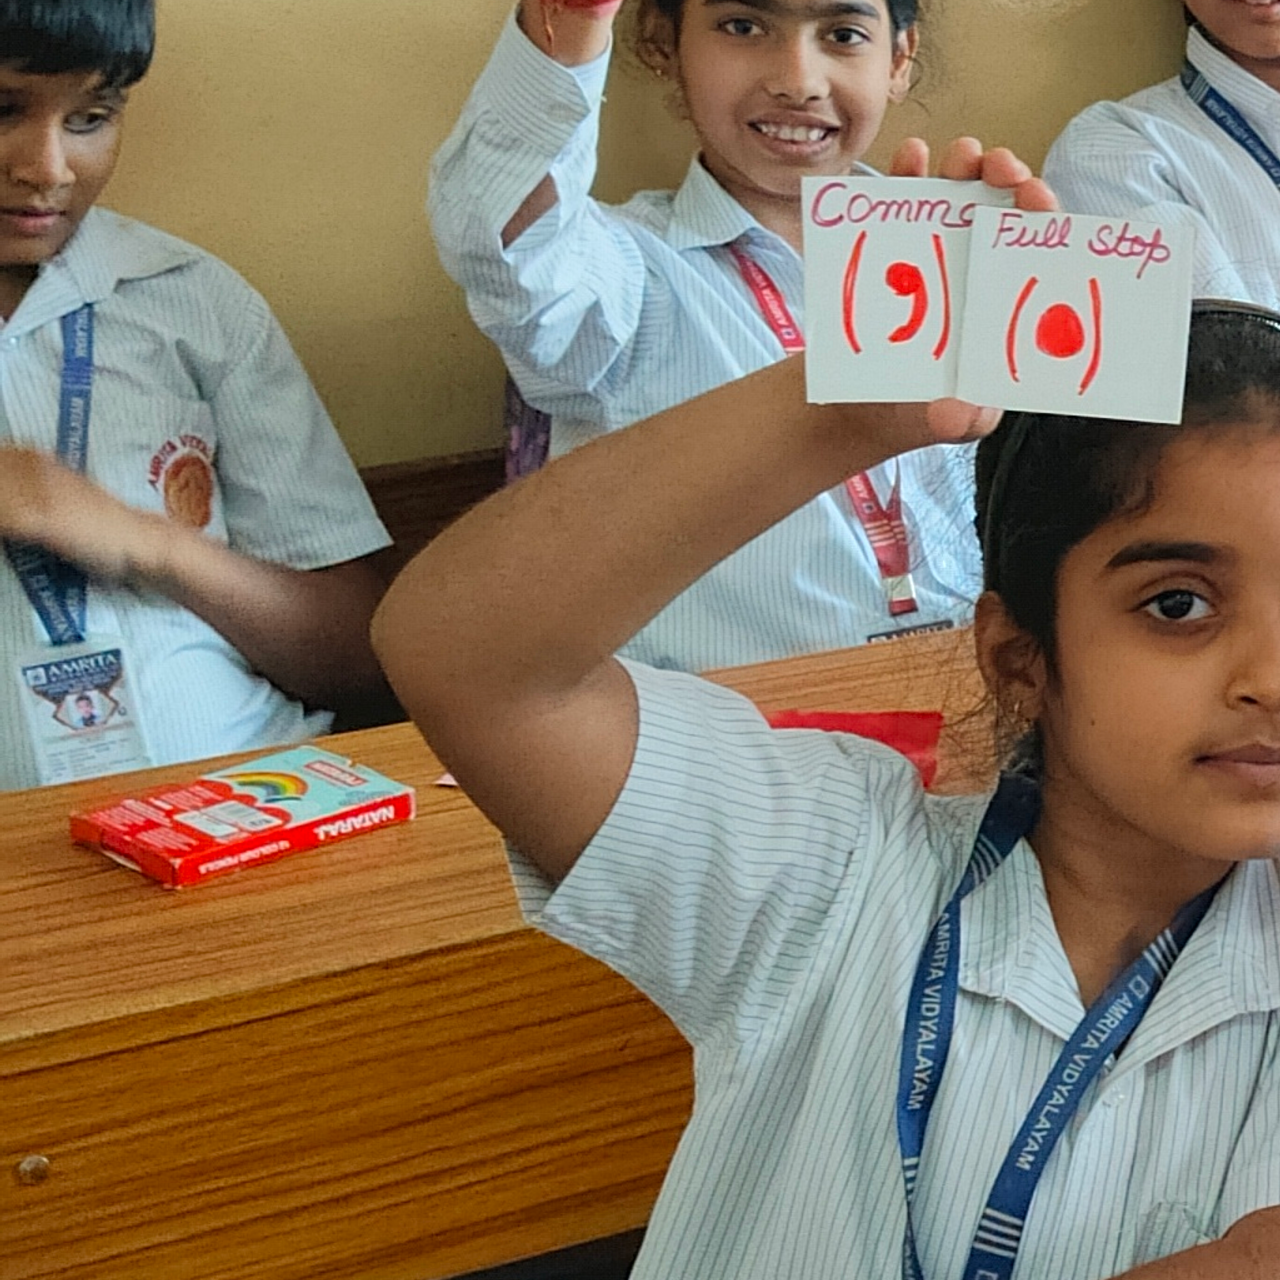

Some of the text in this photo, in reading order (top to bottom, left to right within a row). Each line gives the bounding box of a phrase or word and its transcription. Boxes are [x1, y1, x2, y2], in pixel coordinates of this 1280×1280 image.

[991, 212, 1071, 250] Full
[313, 805, 396, 841] NATARAJ
[906, 983, 943, 1111] VIDYALAYAM
[1016, 993, 1135, 1171] AMRITA VIDYALAYAM
